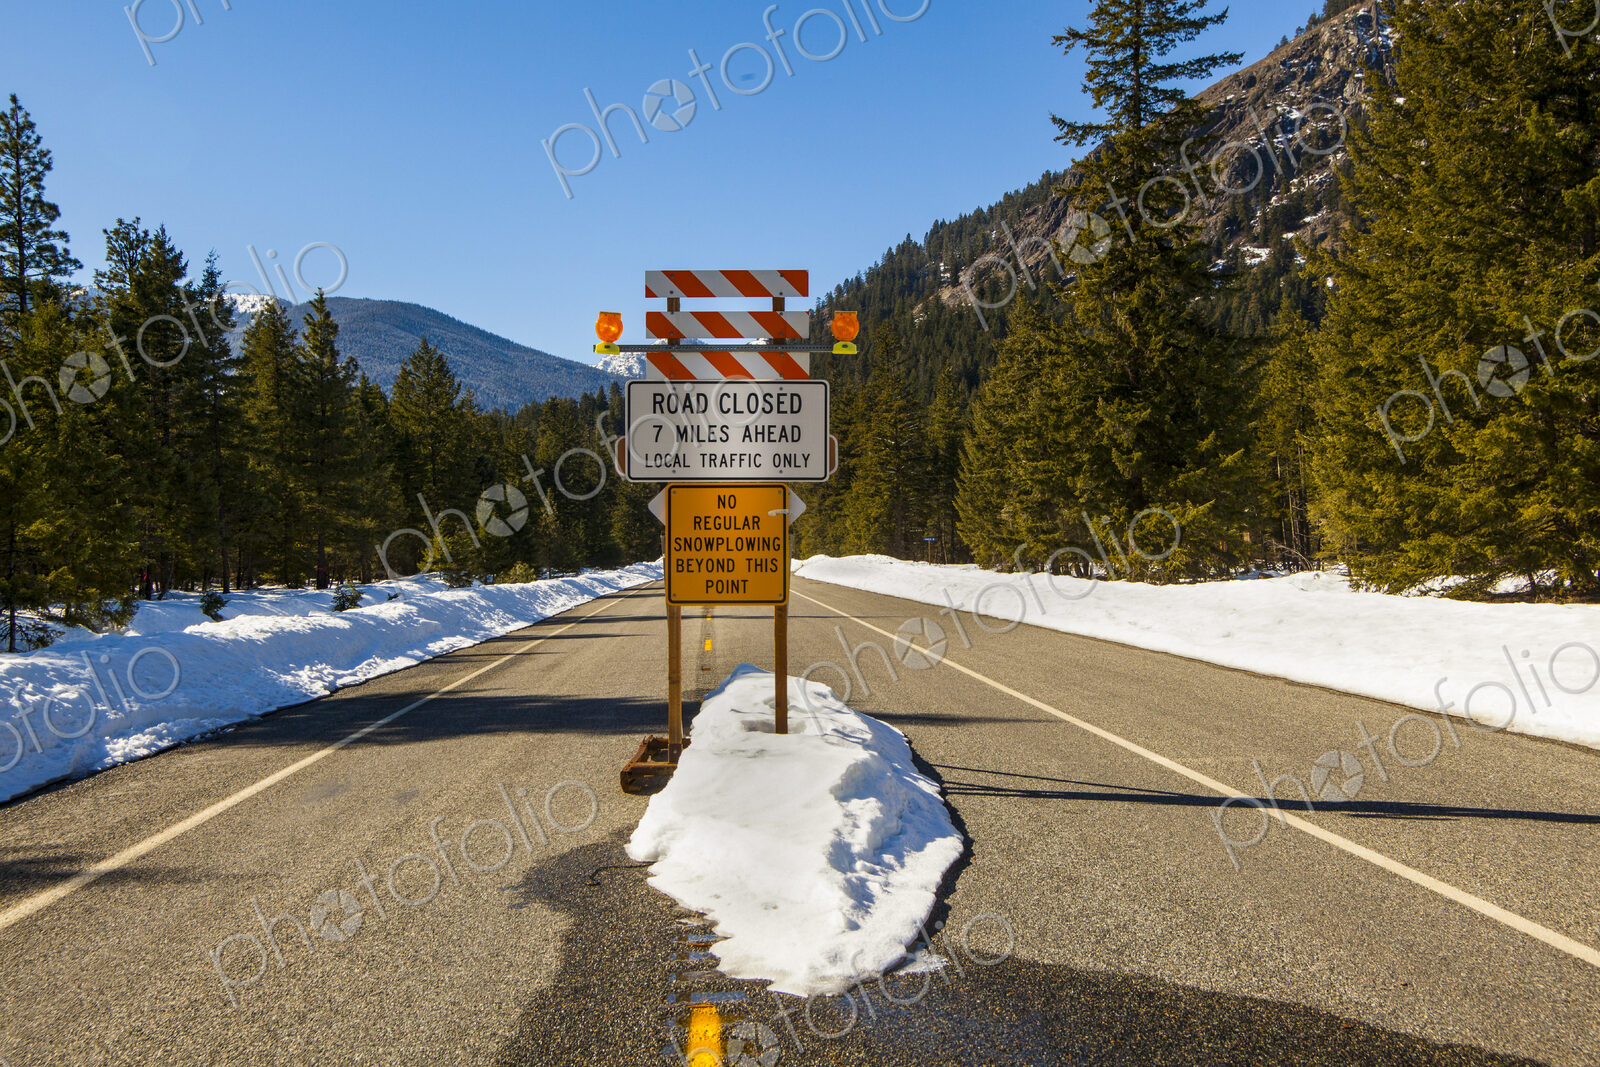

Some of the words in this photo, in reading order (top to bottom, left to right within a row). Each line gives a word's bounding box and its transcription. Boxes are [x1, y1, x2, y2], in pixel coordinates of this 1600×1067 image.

[652, 393, 708, 414] ROAD
[719, 393, 802, 414] CLOSED
[653, 425, 663, 442] 7
[676, 425, 729, 442] MILES
[742, 425, 801, 442] AHEAD
[645, 453, 690, 468] LOCAL
[700, 453, 762, 468] TRAFFIC
[773, 453, 810, 468] ONLY
[718, 495, 736, 509] NO
[694, 516, 760, 530] REGULAR
[674, 537, 781, 551] SNOWPLOWING
[676, 558, 735, 573] BEYOND
[745, 558, 778, 573] THIS
[706, 579, 748, 594] POINT
